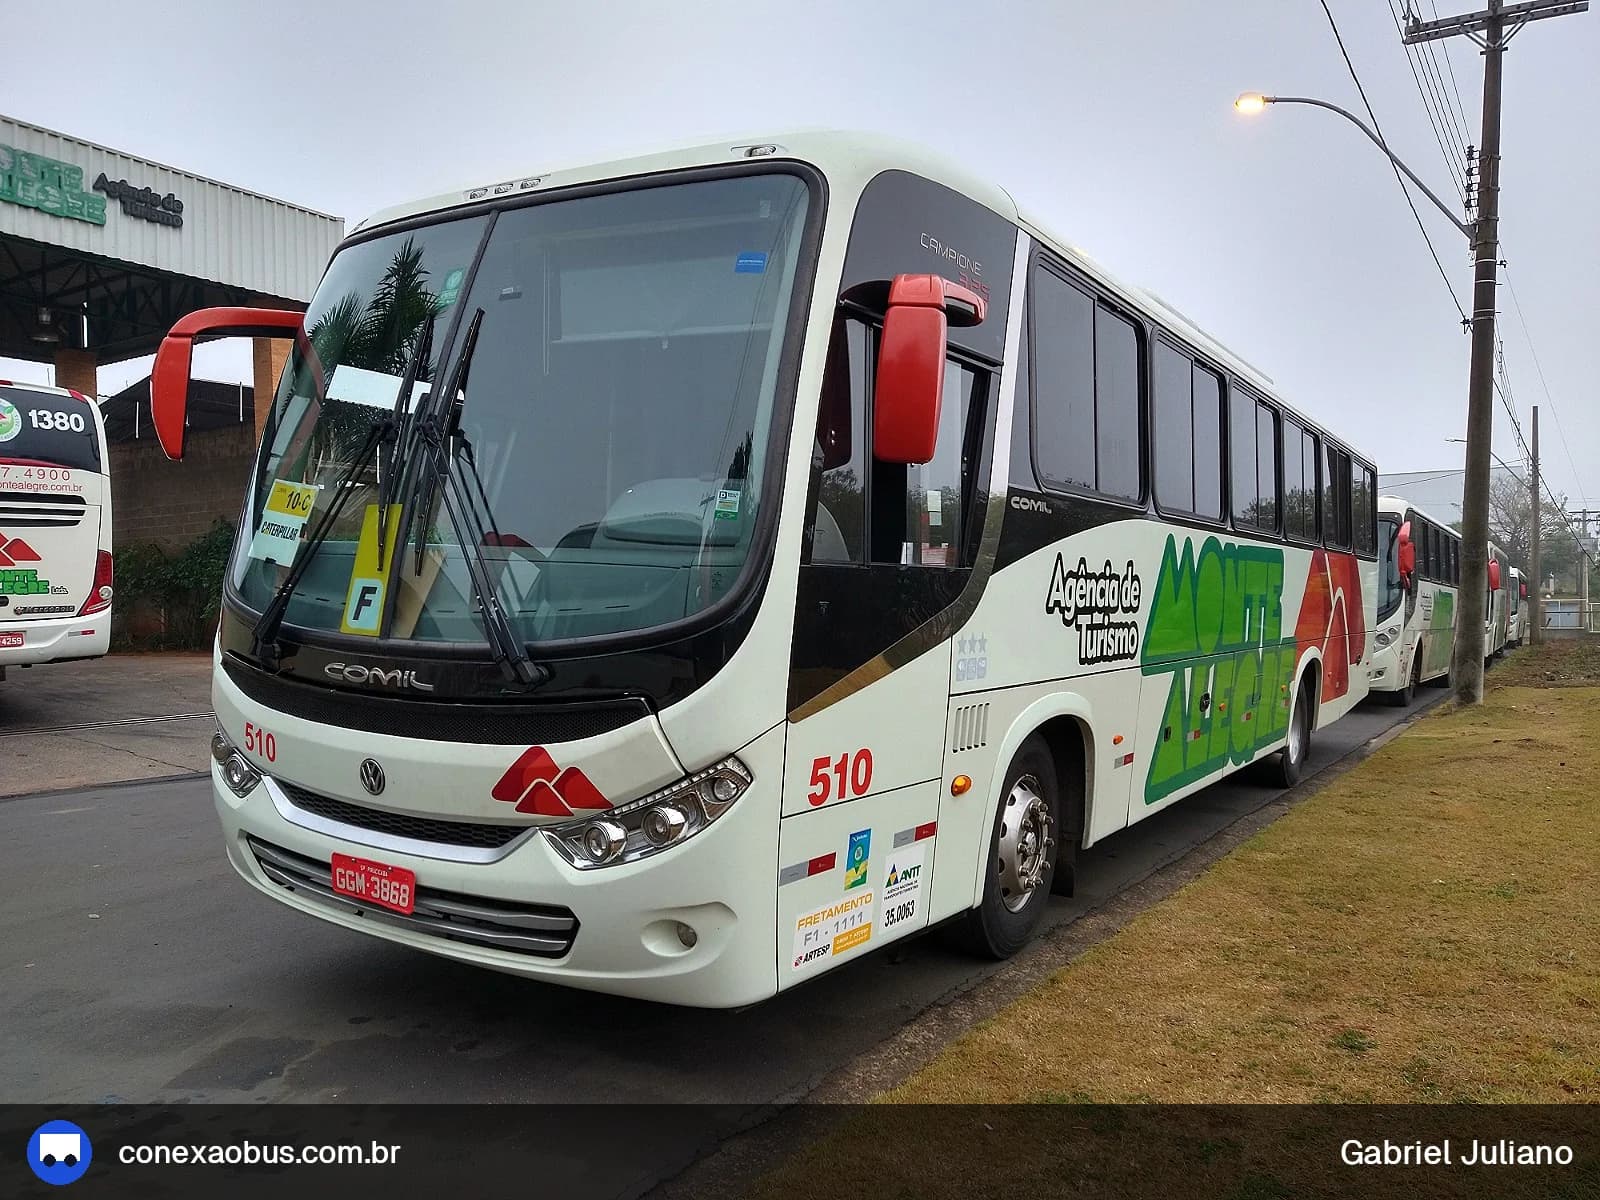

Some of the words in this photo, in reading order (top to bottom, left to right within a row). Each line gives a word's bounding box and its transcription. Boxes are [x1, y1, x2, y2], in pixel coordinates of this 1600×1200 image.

[120, 199, 184, 227] Turismo
[162, 193, 184, 214] de
[920, 232, 983, 276] CAMPIONE
[29, 409, 85, 432] 1380
[1010, 496, 1053, 514] COMIL
[261, 521, 300, 541] CATERPILLAR
[353, 586, 377, 620] F
[1046, 552, 1120, 626] Agência
[1115, 560, 1141, 614] de
[1144, 533, 1284, 668] MONTE
[1076, 613, 1138, 665] Turismo
[324, 662, 434, 692] COMIL
[1144, 645, 1297, 805] ALEGRE
[245, 722, 276, 762] 510
[808, 748, 873, 807] 510
[899, 864, 922, 882] ANTT
[797, 893, 874, 931] FRETAMENTO
[884, 900, 916, 928] 35.0063
[803, 929, 819, 946] F1
[803, 944, 831, 963] ARTESP
